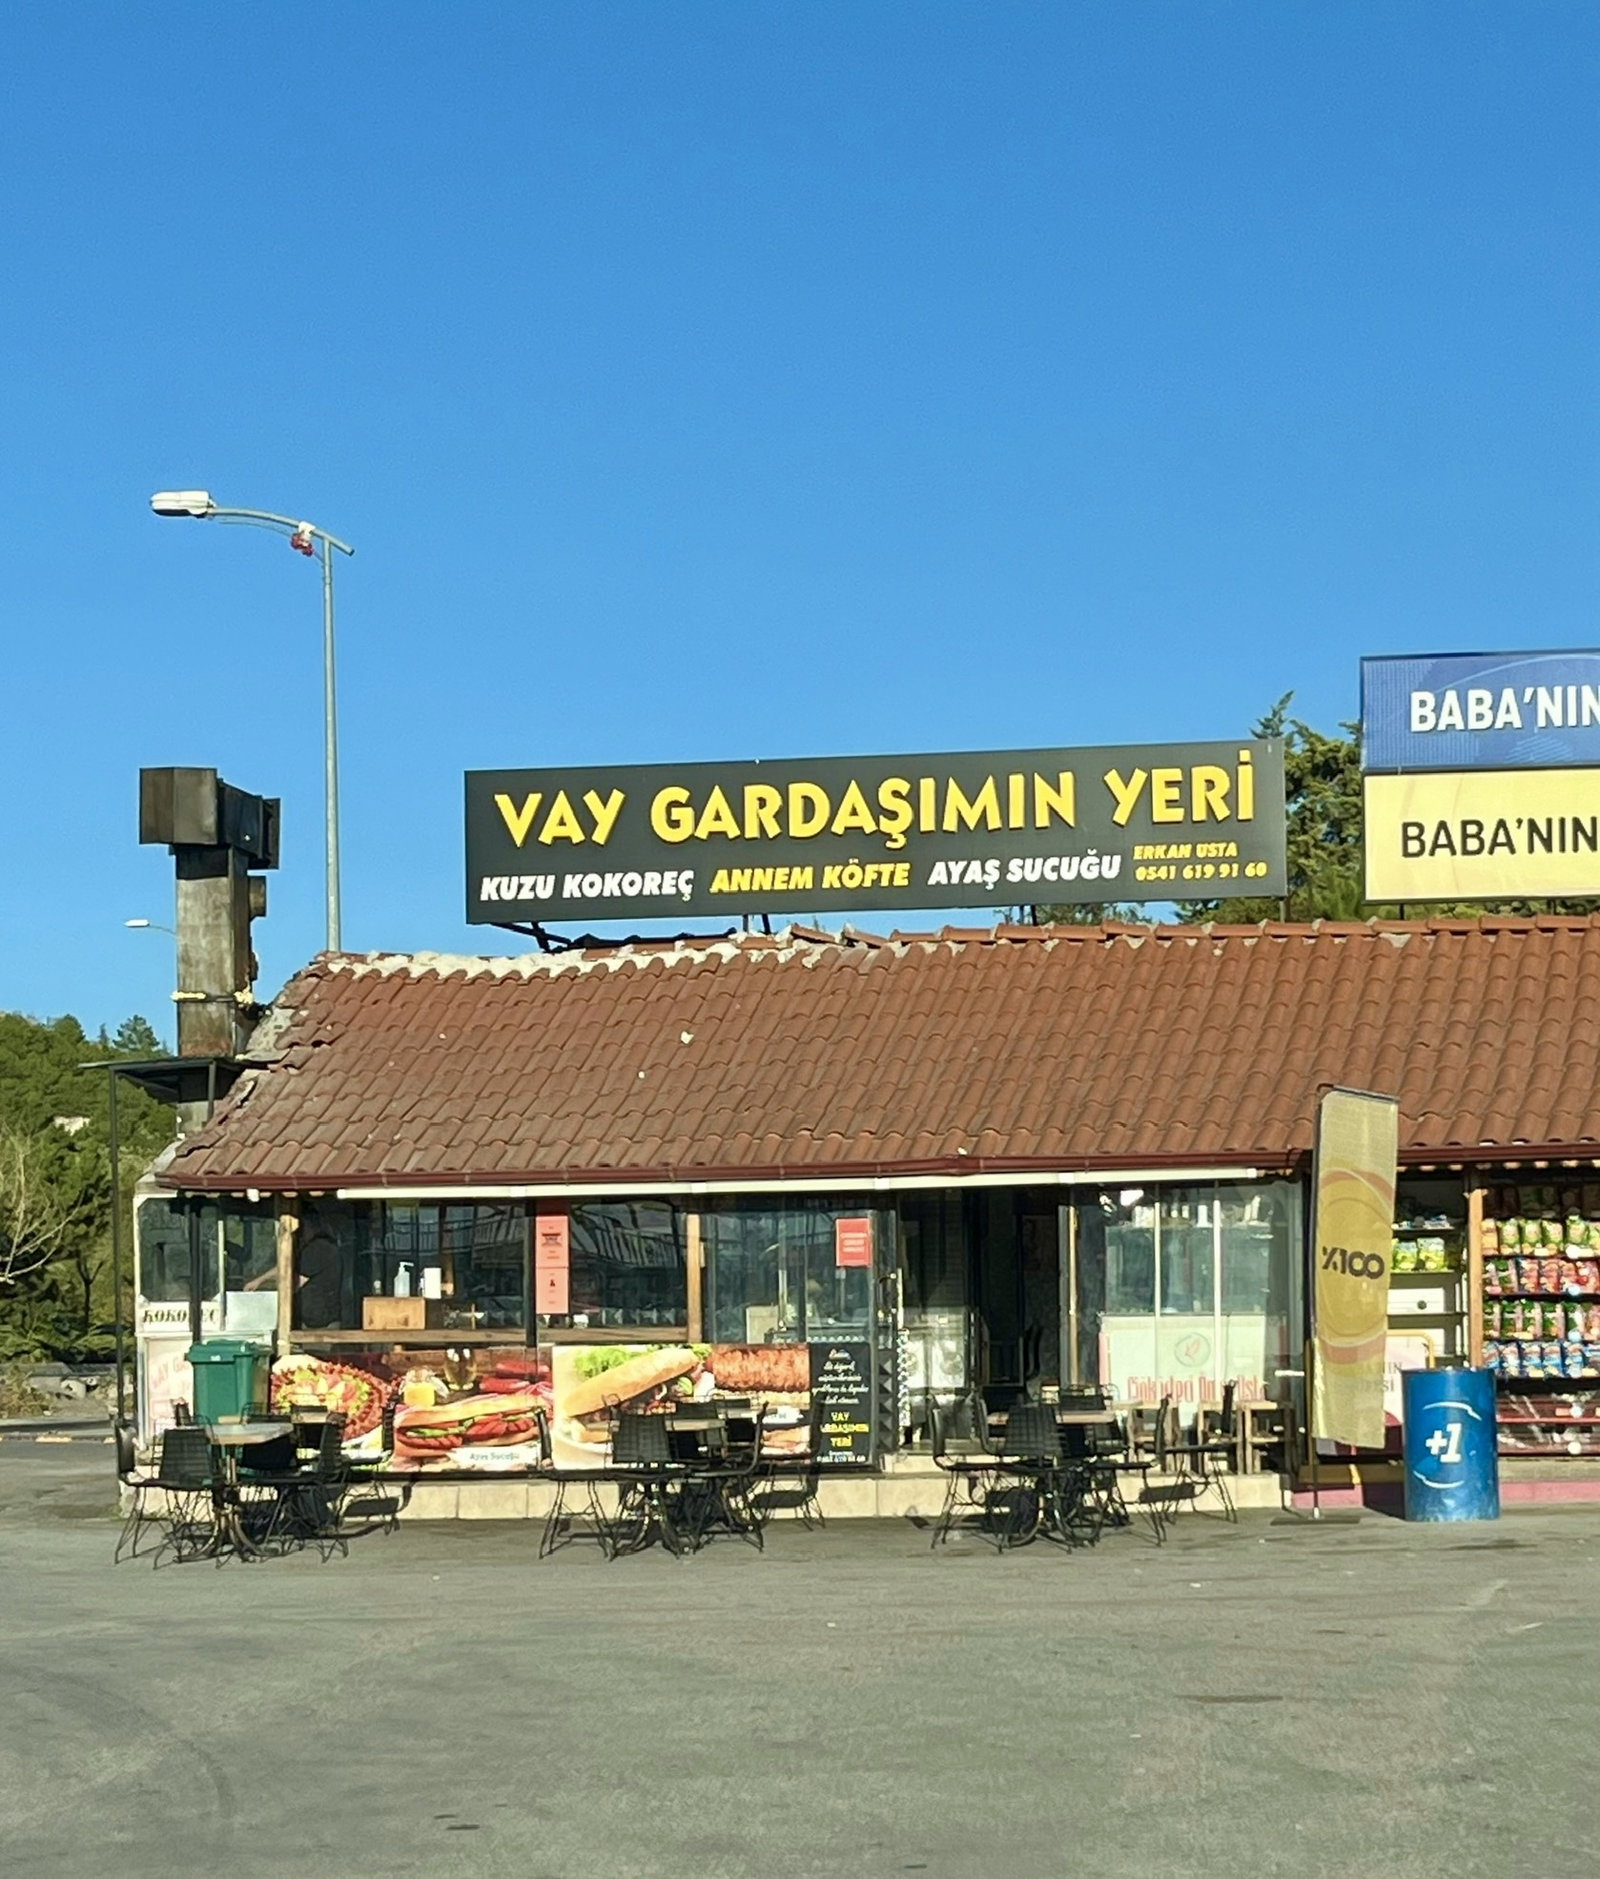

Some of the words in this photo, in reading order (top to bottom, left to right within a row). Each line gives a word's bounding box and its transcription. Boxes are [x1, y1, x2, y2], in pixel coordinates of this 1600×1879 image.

[494, 788, 625, 848] VAY
[651, 771, 1075, 849] GARDAŞIMIN
[1103, 749, 1254, 827] YERİ
[1133, 844, 1192, 860] ERKAN
[1196, 842, 1238, 858] USTA
[1401, 815, 1599, 858] BABA'NIN
[480, 874, 555, 901] KUZU
[562, 870, 694, 902] KOKOREÇ
[709, 866, 814, 894] ANNEM
[822, 858, 911, 889] KÖFTE
[927, 859, 1001, 891] AYAŞ
[1006, 848, 1122, 883] SUCUĞU
[1135, 864, 1176, 881] 0541
[1182, 863, 1215, 880] 619
[1219, 862, 1239, 878] 91
[1244, 861, 1268, 877] 60
[1322, 1246, 1385, 1280] %100
[1425, 1422, 1462, 1463] +1
